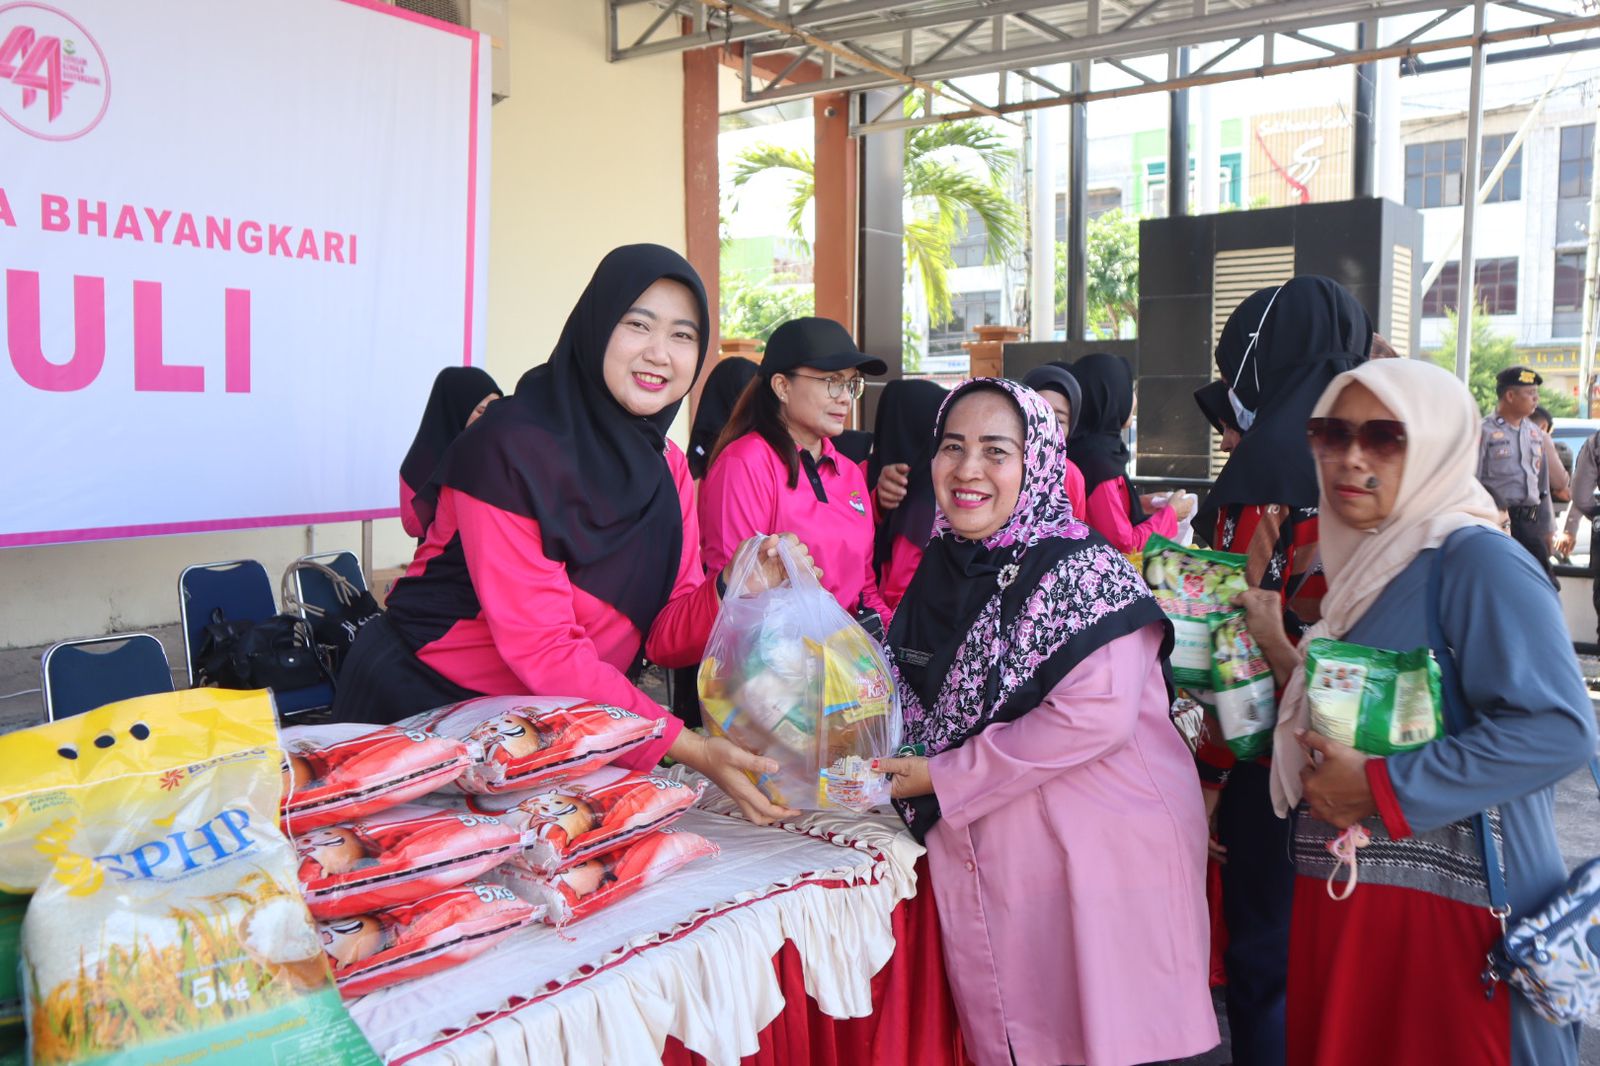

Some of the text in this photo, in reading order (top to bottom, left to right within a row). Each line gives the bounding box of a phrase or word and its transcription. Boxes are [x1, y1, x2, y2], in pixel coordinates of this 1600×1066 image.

[41, 193, 358, 265] BHAYANGKARI
[6, 269, 251, 394] ULI
[95, 808, 256, 882] SPHP
